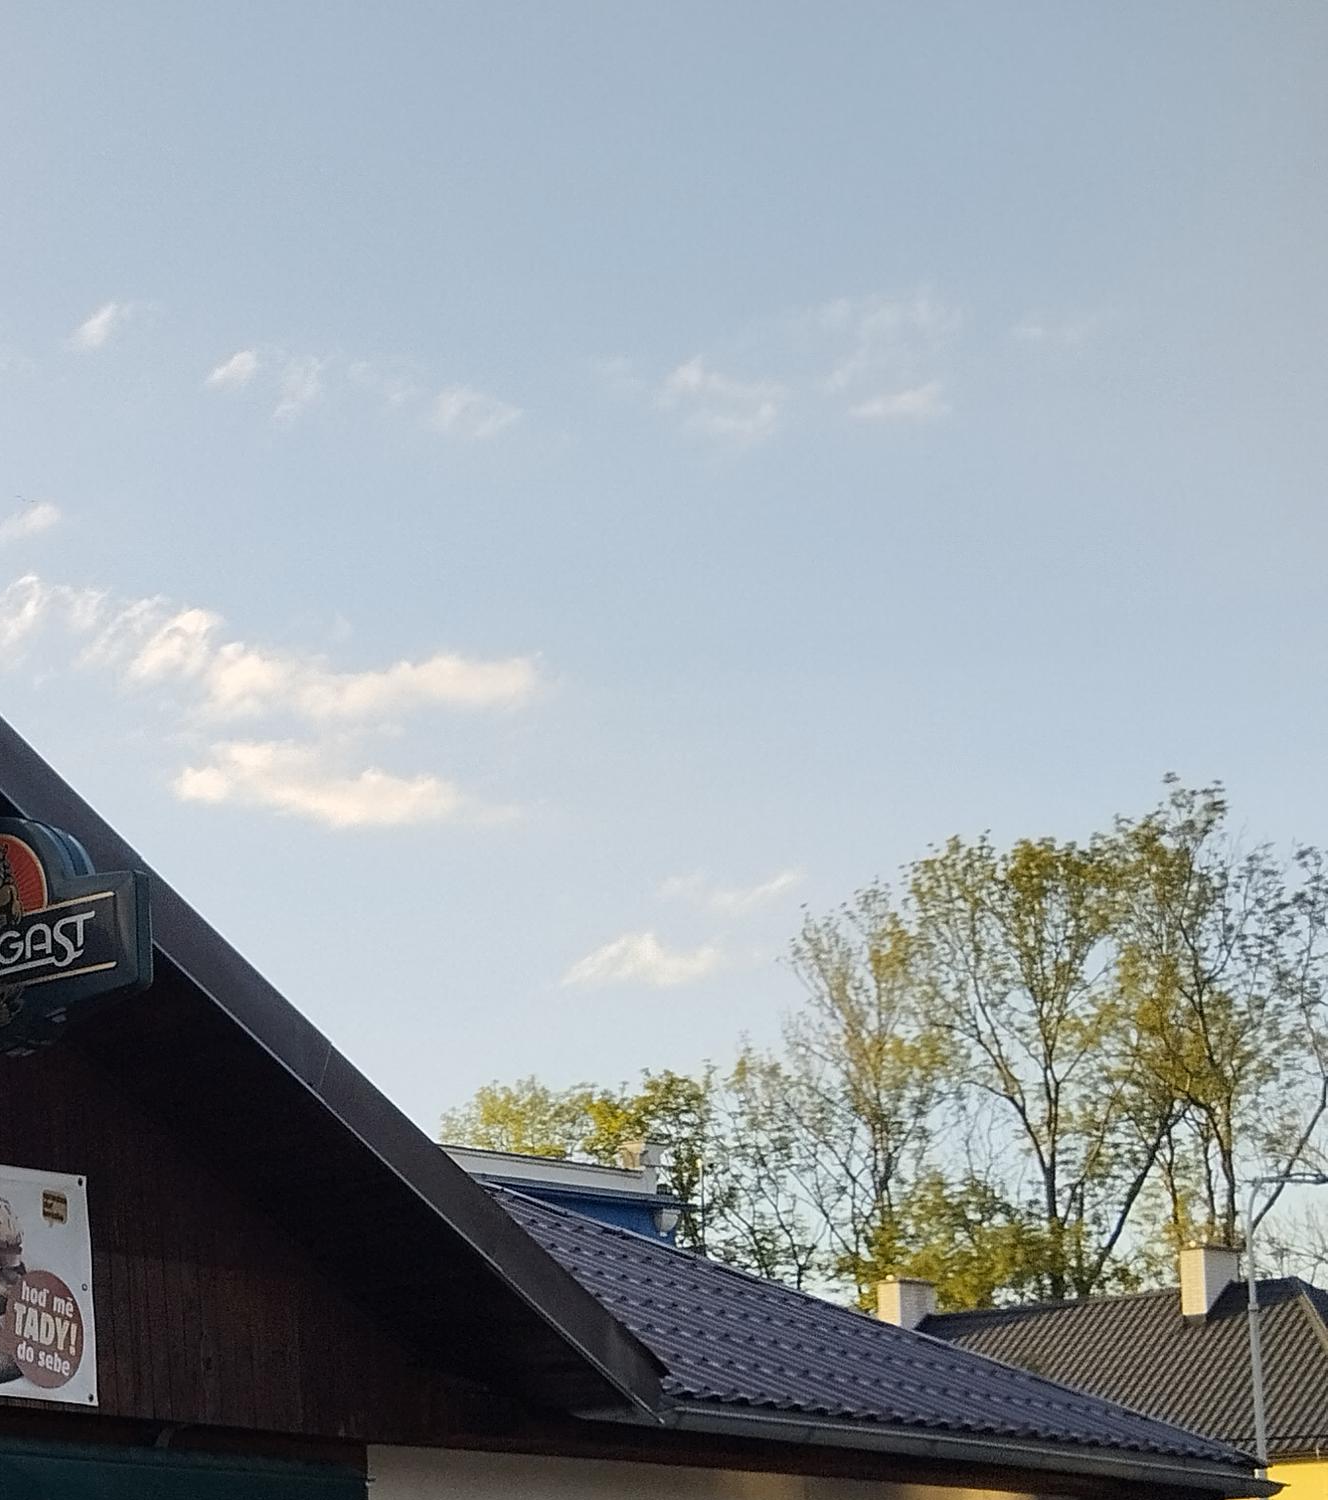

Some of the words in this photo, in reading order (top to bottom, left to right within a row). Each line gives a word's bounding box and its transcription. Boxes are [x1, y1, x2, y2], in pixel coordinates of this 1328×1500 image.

[21, 1280, 50, 1307] hoď
[52, 1296, 74, 1318] mě
[13, 1302, 78, 1356] TADY!
[16, 1340, 34, 1362] do
[37, 1350, 71, 1377] sebe
